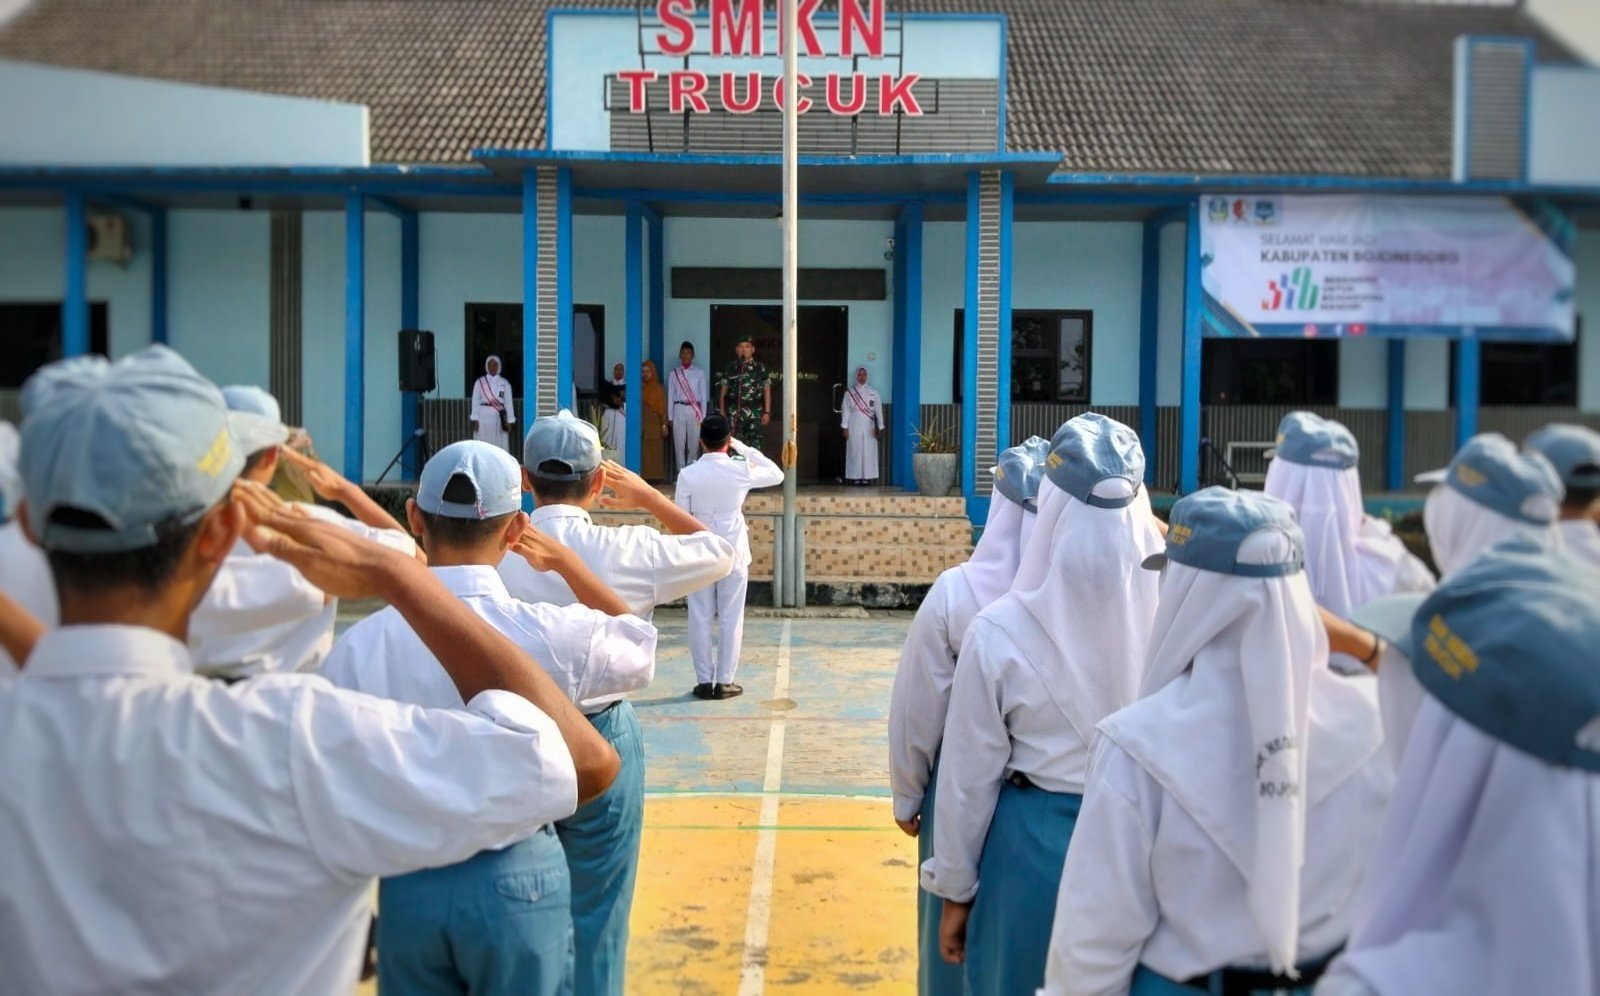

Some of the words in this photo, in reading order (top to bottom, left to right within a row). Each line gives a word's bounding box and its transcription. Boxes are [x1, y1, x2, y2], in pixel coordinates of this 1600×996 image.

[656, 0, 885, 58] SMKN
[617, 70, 923, 116] TRUCUK
[1260, 233, 1315, 246] SELAMAT
[1260, 249, 1348, 264] KABUPATEN
[1353, 250, 1459, 265] BOJONEGORO
